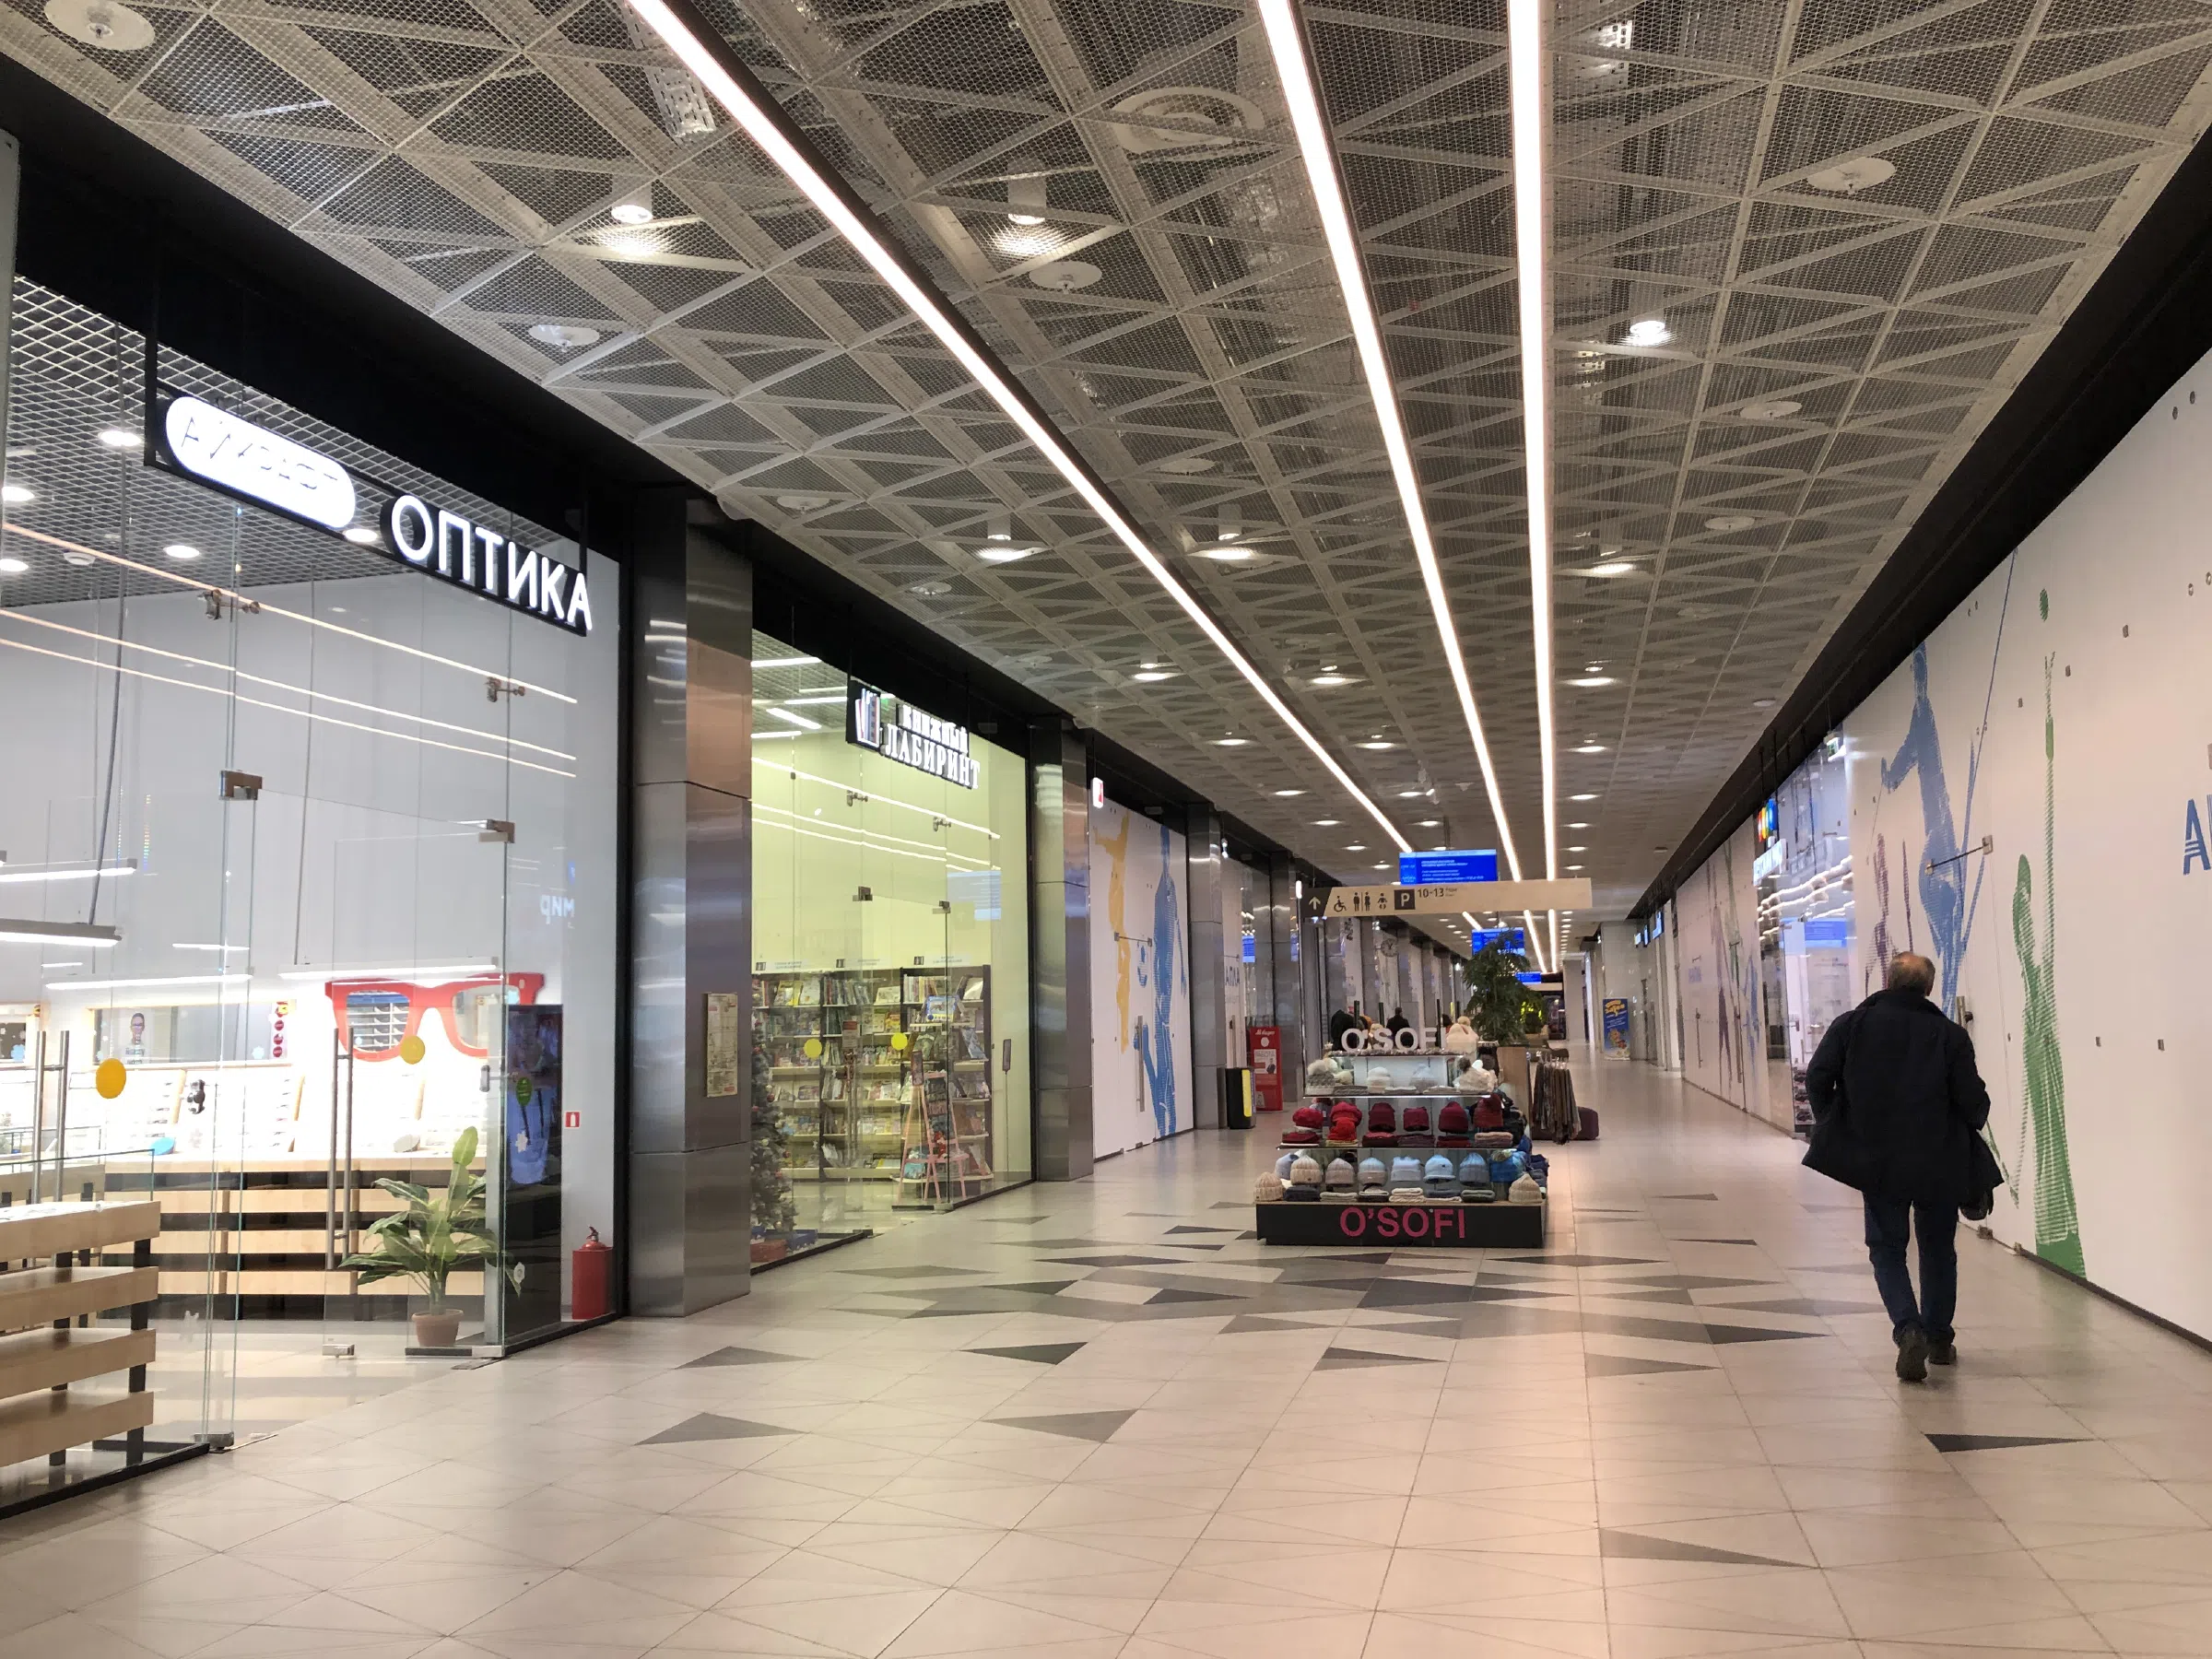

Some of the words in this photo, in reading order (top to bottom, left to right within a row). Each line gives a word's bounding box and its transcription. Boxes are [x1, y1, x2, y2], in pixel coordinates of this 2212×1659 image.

[391, 495, 593, 630] ОПТИКА
[885, 723, 981, 790] ЛАБИРИНТ
[1418, 888, 1444, 899] 10-13
[1339, 1206, 1465, 1239] O'SOFI
